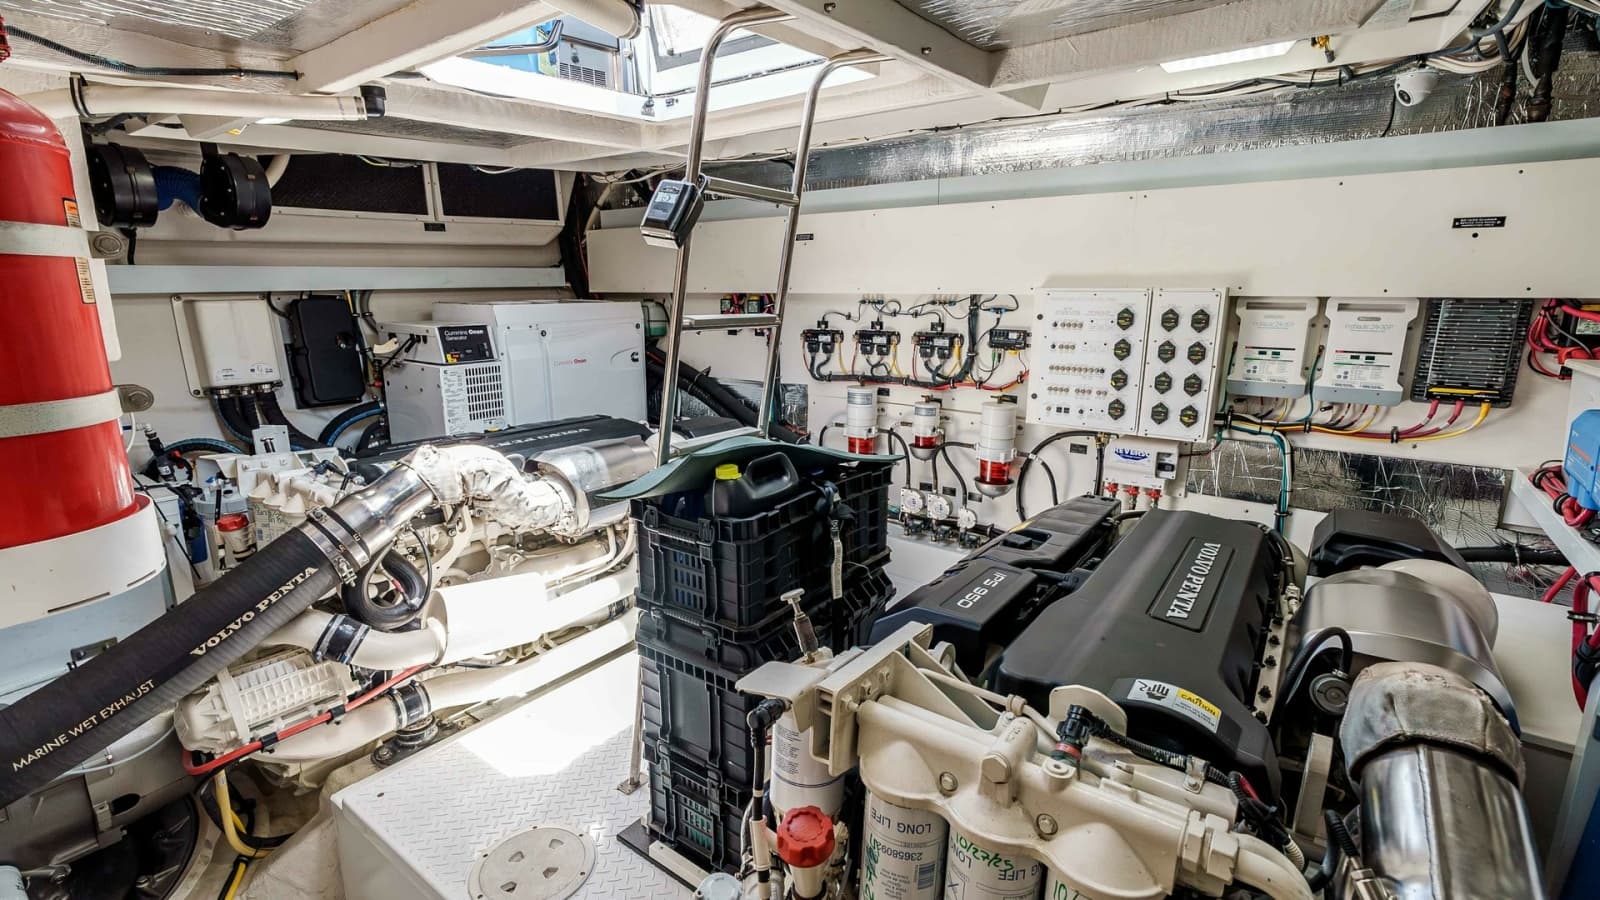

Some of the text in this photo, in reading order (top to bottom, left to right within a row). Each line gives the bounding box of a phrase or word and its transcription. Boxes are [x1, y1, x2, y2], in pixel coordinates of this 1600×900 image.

[957, 571, 1008, 609] IPS 950
[1166, 542, 1221, 618] VOLVO PENTA
[190, 566, 319, 655] VOLVO PENTA
[1181, 693, 1217, 717] CAUTION
[12, 679, 156, 773] MARINE WET EXHAUST
[871, 807, 932, 835] LONG LIFE
[955, 831, 1015, 871] 10/27/25
[997, 868, 1026, 881] LIFE
